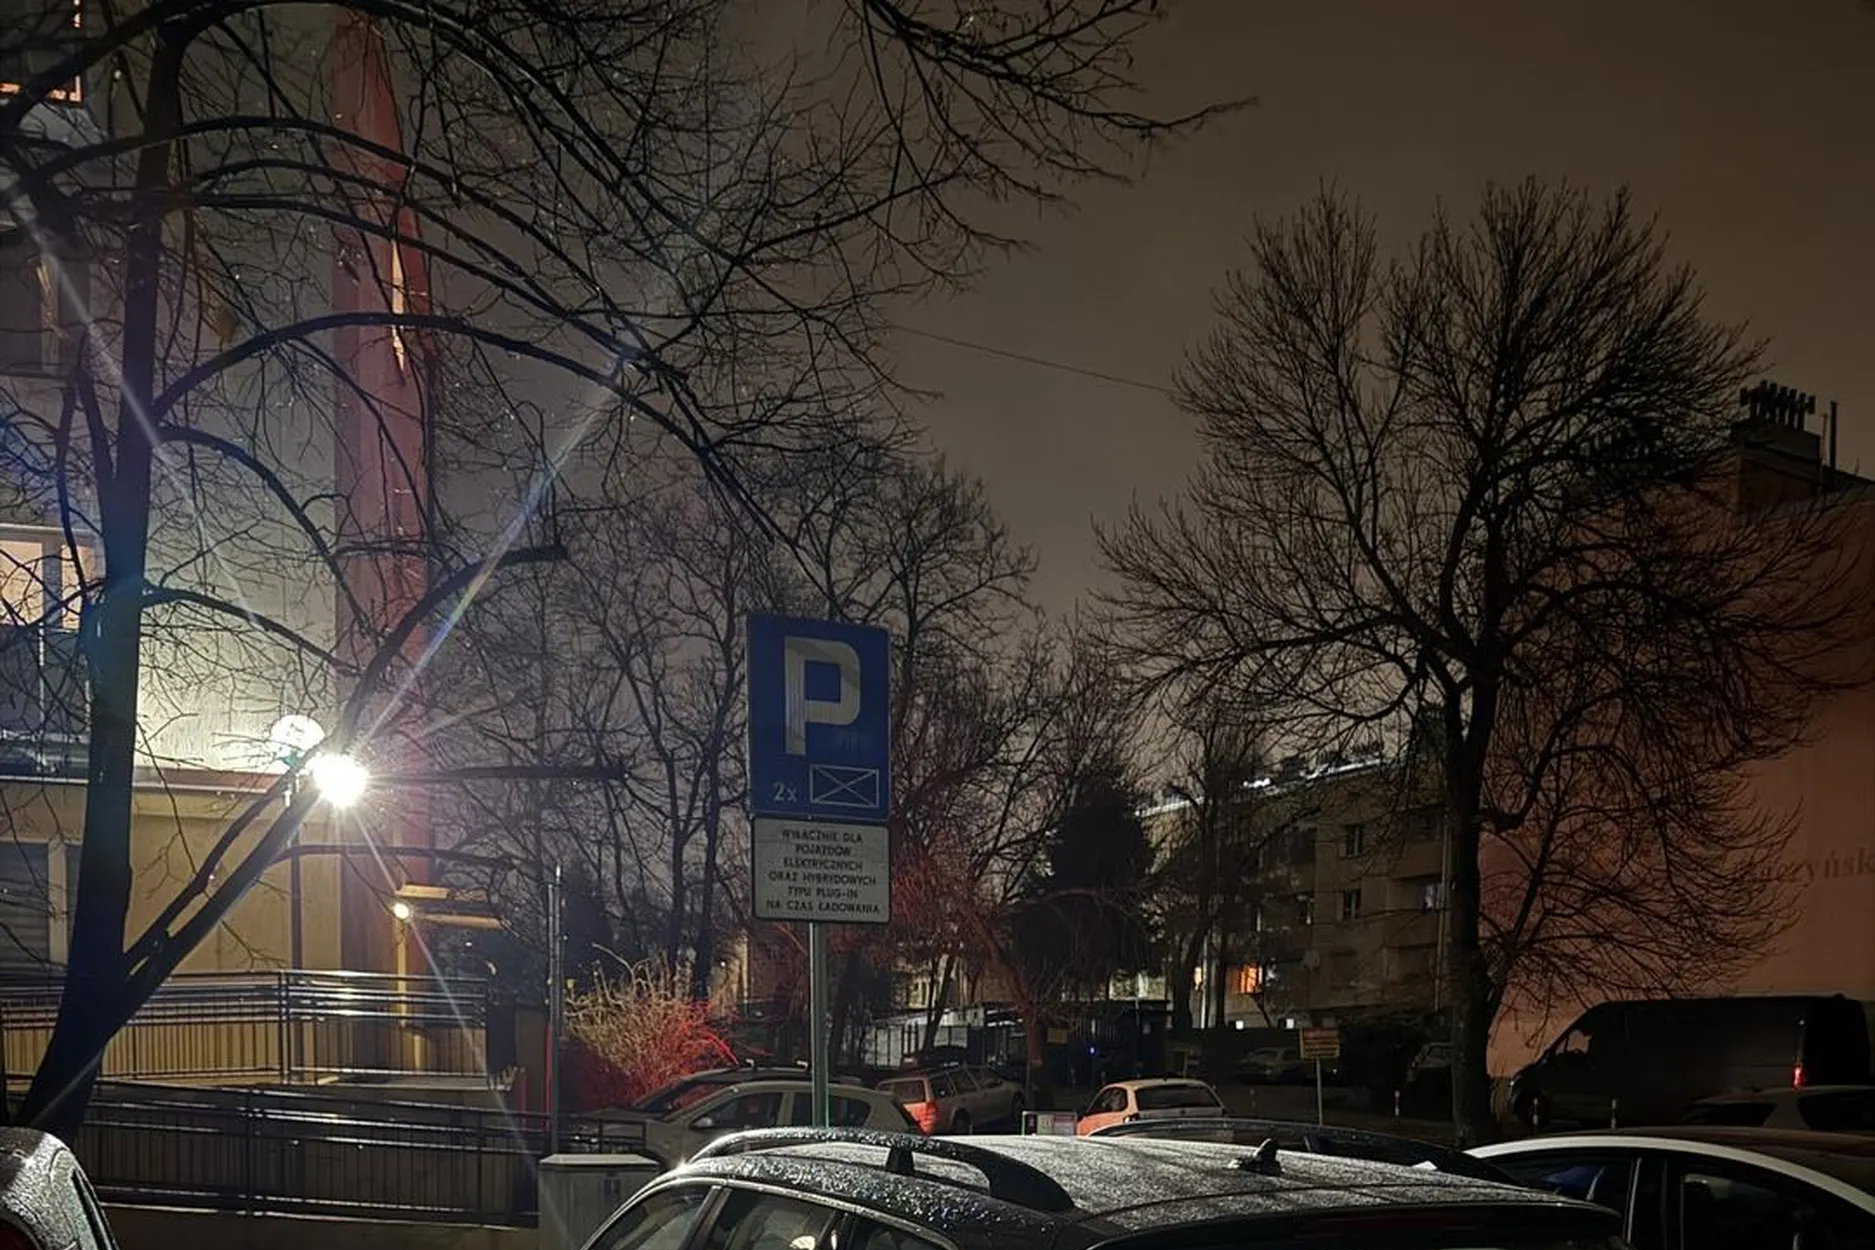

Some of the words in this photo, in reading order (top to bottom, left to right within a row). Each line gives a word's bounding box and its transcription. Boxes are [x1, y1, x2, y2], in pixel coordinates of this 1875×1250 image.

[784, 635, 861, 756] P
[772, 781, 798, 803] 2x
[843, 832, 863, 844] DLA
[783, 857, 863, 872] ELEKTRYCZNYCH
[768, 871, 798, 883] ORAZ
[803, 872, 876, 887] HYBRYDOWYCH
[788, 886, 811, 898] TYPU
[816, 887, 859, 899] PLUG-IN
[766, 900, 780, 910] NA
[786, 900, 813, 911] CZAS
[818, 901, 880, 914] ŁADOWANIA
